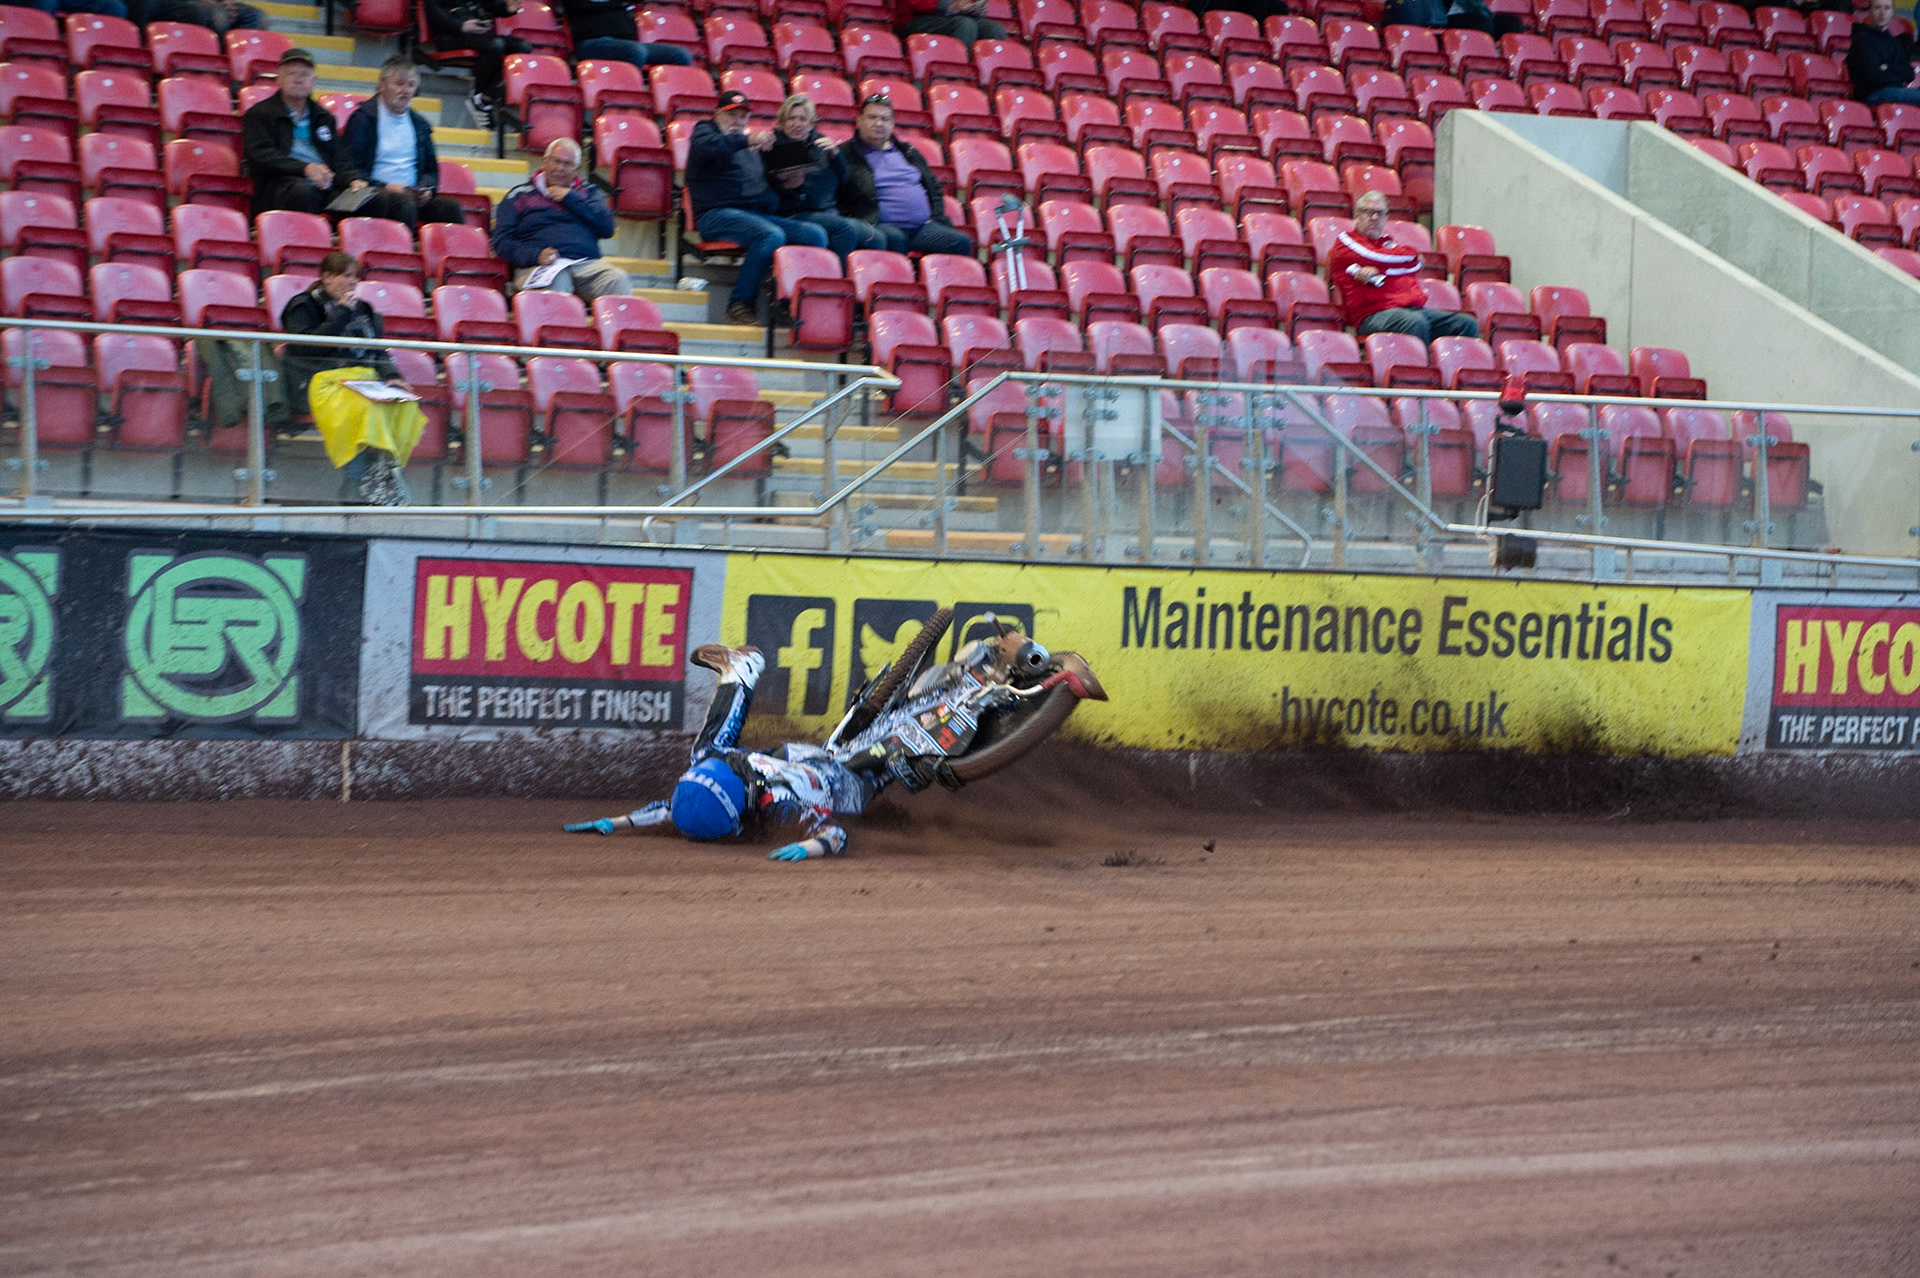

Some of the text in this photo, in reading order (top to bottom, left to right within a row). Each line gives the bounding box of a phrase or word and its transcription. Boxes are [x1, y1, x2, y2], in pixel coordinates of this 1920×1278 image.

[423, 574, 681, 667] HYCOTE
[1121, 586, 1673, 663] Maintenance Essentials
[422, 685, 672, 723] THE PERFECT FINISH
[1281, 686, 1508, 740] hycote.co.uk
[1778, 714, 1817, 744] THE
[1819, 715, 1909, 745] PERFECT
